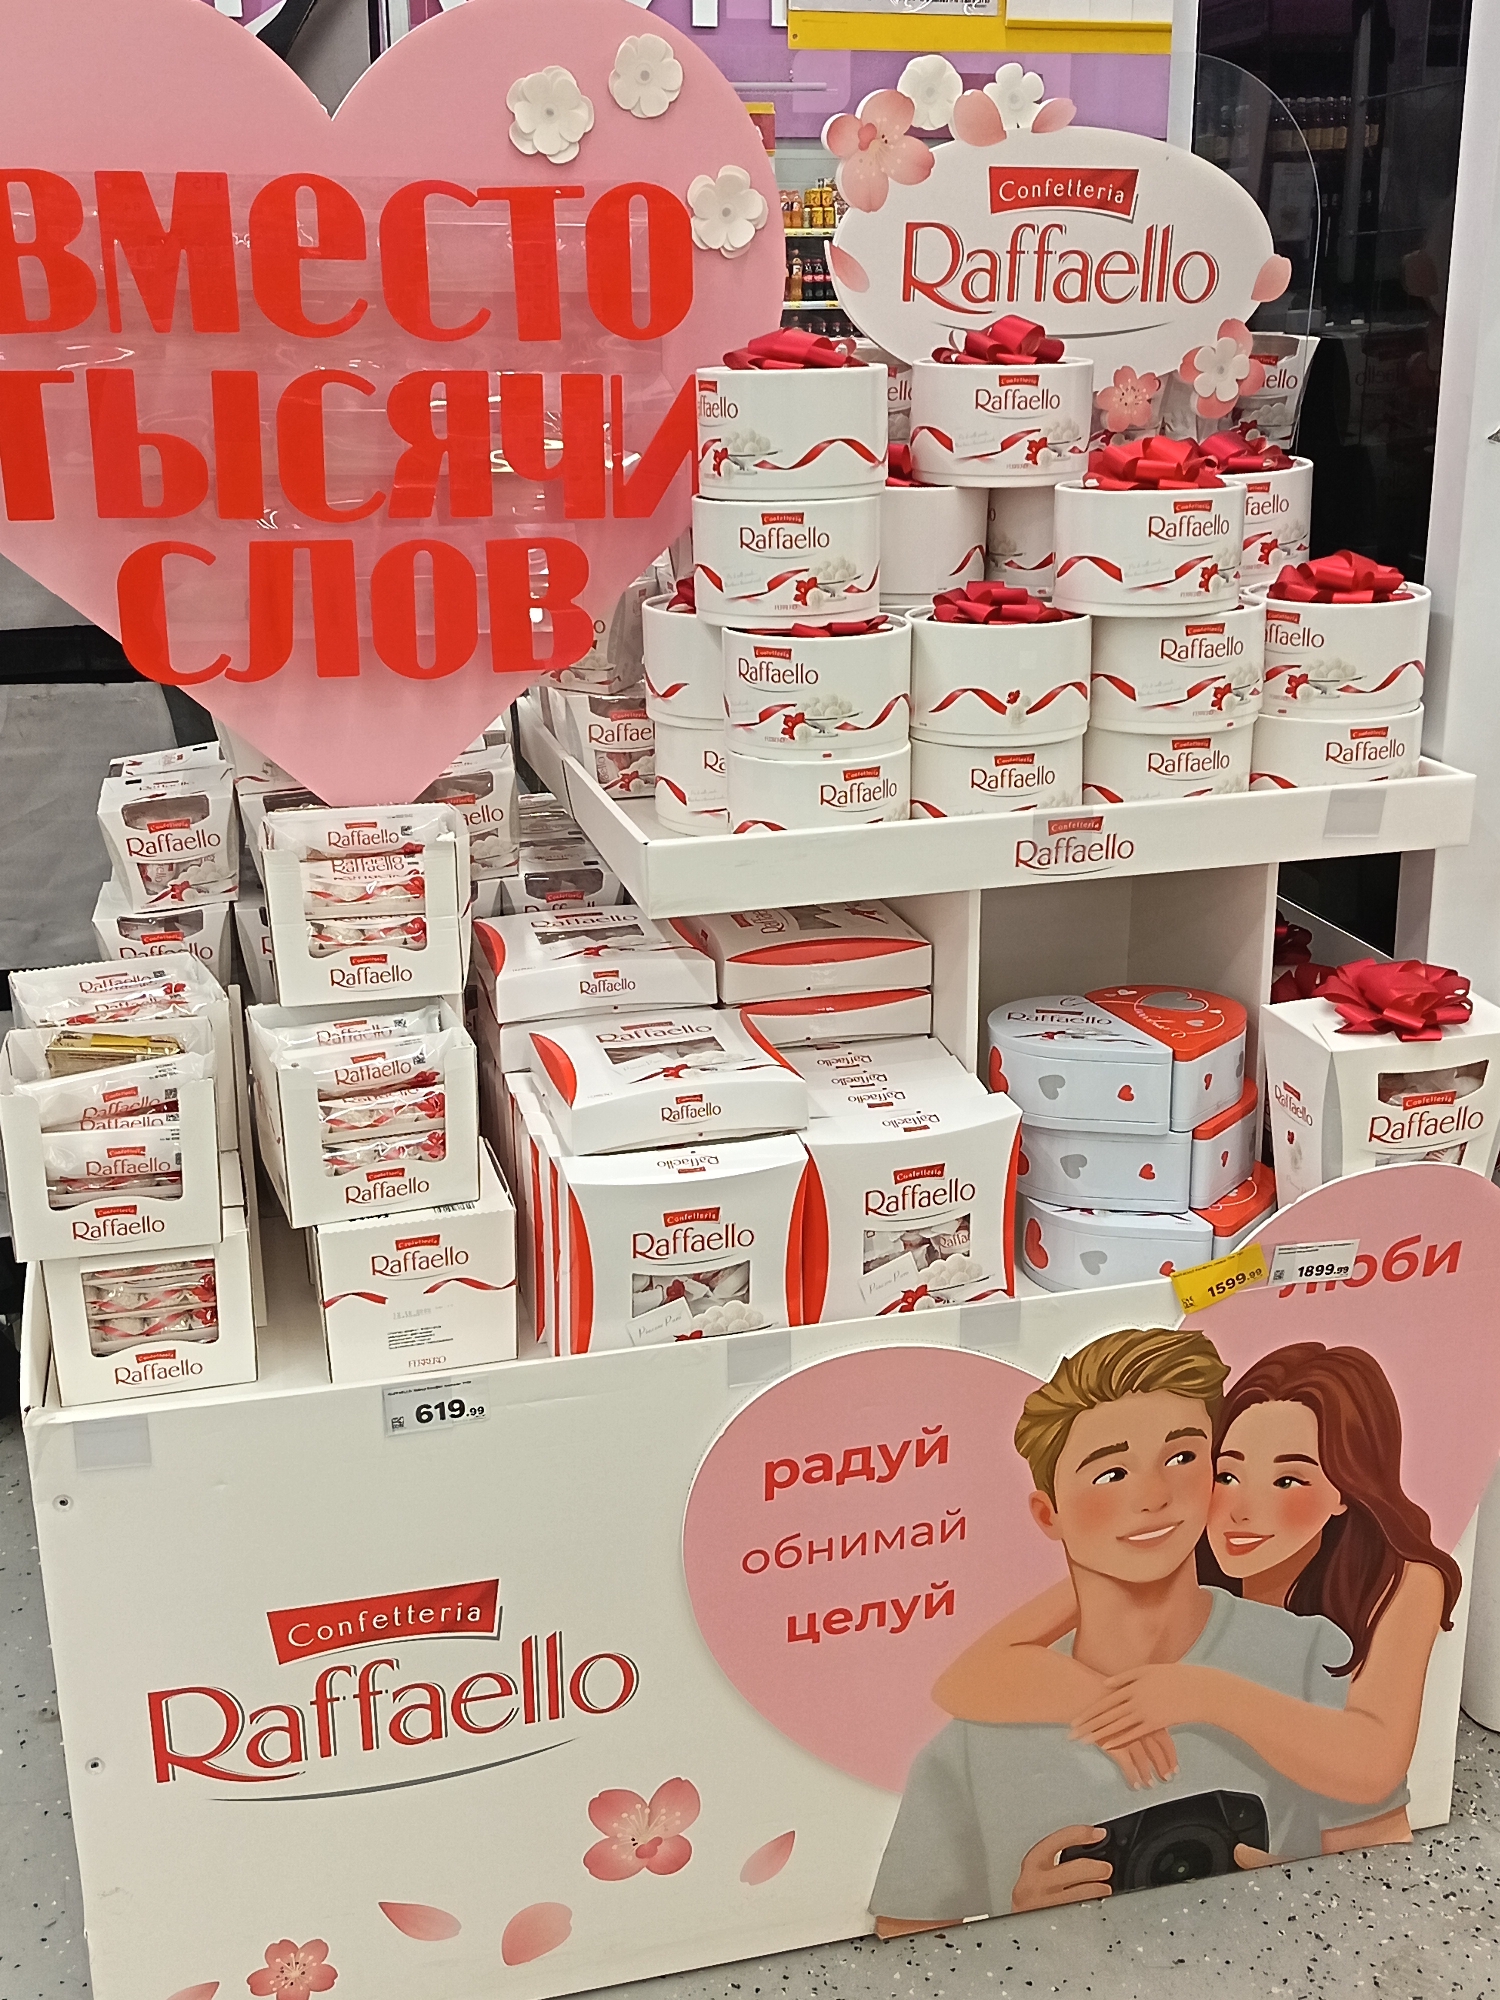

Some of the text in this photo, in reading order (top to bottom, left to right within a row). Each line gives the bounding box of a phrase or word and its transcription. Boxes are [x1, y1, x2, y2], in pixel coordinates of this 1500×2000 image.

[999, 178, 1125, 204] Confetteria
[902, 221, 1220, 315] Raffaello
[974, 388, 1061, 414] Raffaello
[739, 526, 830, 552] Raffaello
[1148, 514, 1230, 541] Raffaello
[116, 536, 594, 686] СЛОВ
[1160, 635, 1244, 663] Raffaello
[738, 658, 819, 685] Raffaello
[588, 723, 656, 745] Raffael
[1147, 750, 1230, 776] Raffaello
[1325, 739, 1405, 765] Raffaello
[970, 766, 1056, 792] Raffaello
[819, 779, 898, 808] Raffaello
[125, 829, 221, 858] Raffaello
[327, 828, 400, 848] Raffaello
[1015, 833, 1135, 871] Raffaello
[530, 914, 639, 928] Raffaello
[329, 965, 413, 988] Raffaello
[580, 978, 637, 995] Raffaello
[1007, 1011, 1112, 1026] Raffaello
[595, 1024, 713, 1044] Raffaello
[334, 1059, 412, 1086] Raffaello
[660, 1102, 722, 1123] Raffaello
[1274, 1084, 1313, 1127] Raffaello
[1368, 1105, 1484, 1144] Raffaello
[86, 1157, 171, 1177] Raffaello
[345, 1176, 430, 1205] Raffaello
[865, 1178, 976, 1216] Raffaello
[72, 1215, 165, 1241] Raffaello
[632, 1222, 755, 1261] Raffaello
[371, 1245, 469, 1278] Raffaello
[1298, 1263, 1350, 1278] 1899.99
[1208, 1267, 1263, 1298] 1599.99
[114, 1359, 204, 1386] Raffaello
[415, 1398, 485, 1424] 619.99
[764, 1424, 950, 1501] радуй
[741, 1508, 967, 1575] обнимай
[287, 1603, 482, 1648] Confetteria
[786, 1580, 956, 1645] целуй
[147, 1631, 640, 1785] Raffaello
